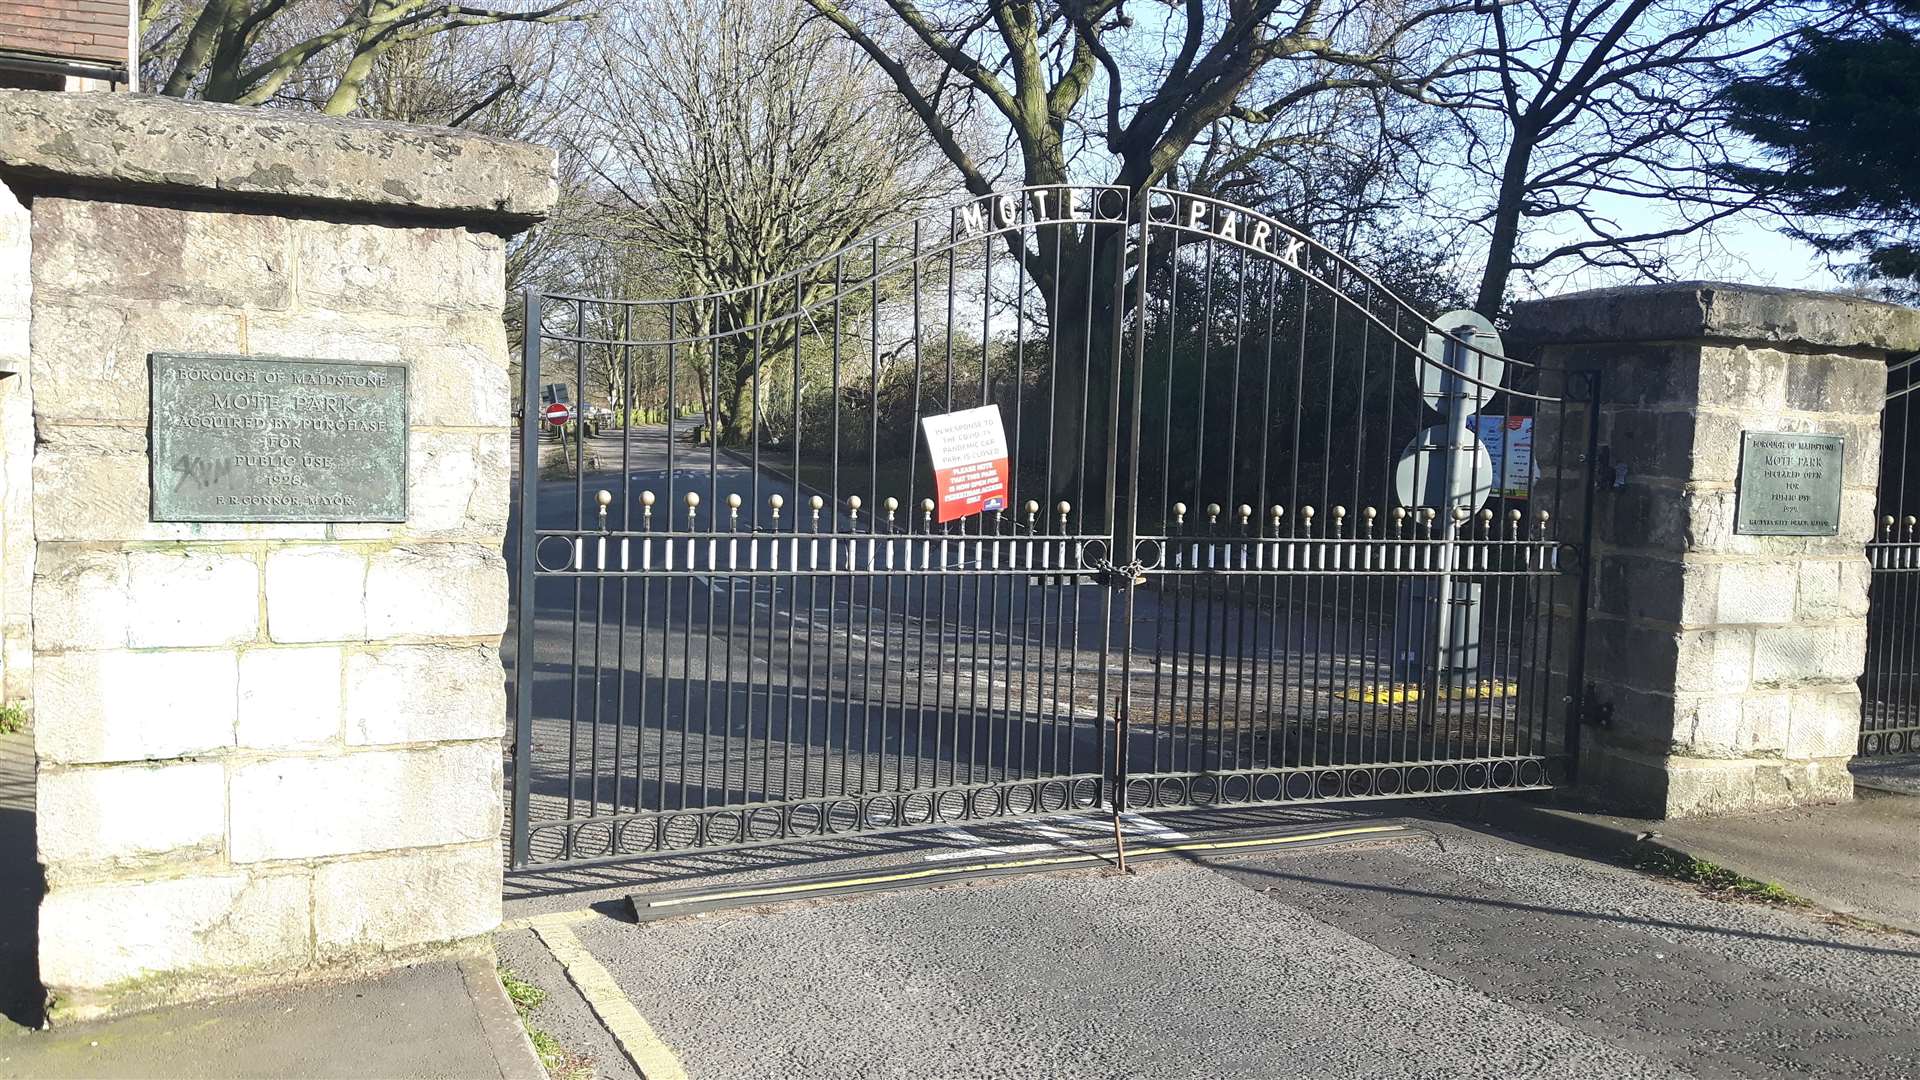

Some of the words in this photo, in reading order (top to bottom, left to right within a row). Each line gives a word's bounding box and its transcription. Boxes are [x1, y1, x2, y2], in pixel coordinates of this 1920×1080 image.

[962, 190, 1090, 234] MOTE
[1188, 200, 1305, 269] PARK
[178, 368, 257, 383] BOROUGH
[264, 371, 286, 384] OF
[292, 373, 387, 388] MAIDSTONE
[212, 392, 280, 410] MOTE
[293, 395, 357, 413] PARK
[178, 415, 266, 428] ACQUIRED
[272, 418, 291, 429] BY
[300, 419, 387, 432] PURCHASE
[269, 438, 302, 449] FOR
[943, 441, 979, 454] PANDEMIC
[235, 455, 296, 467] PUBLIC
[302, 456, 333, 468] USE
[942, 455, 960, 464] PARK
[1765, 455, 1793, 466] MOTE
[1798, 456, 1823, 468] PARK
[953, 465, 977, 476] PLEASE
[1764, 470, 1800, 479] DECLARED
[1803, 471, 1823, 479] OPEN
